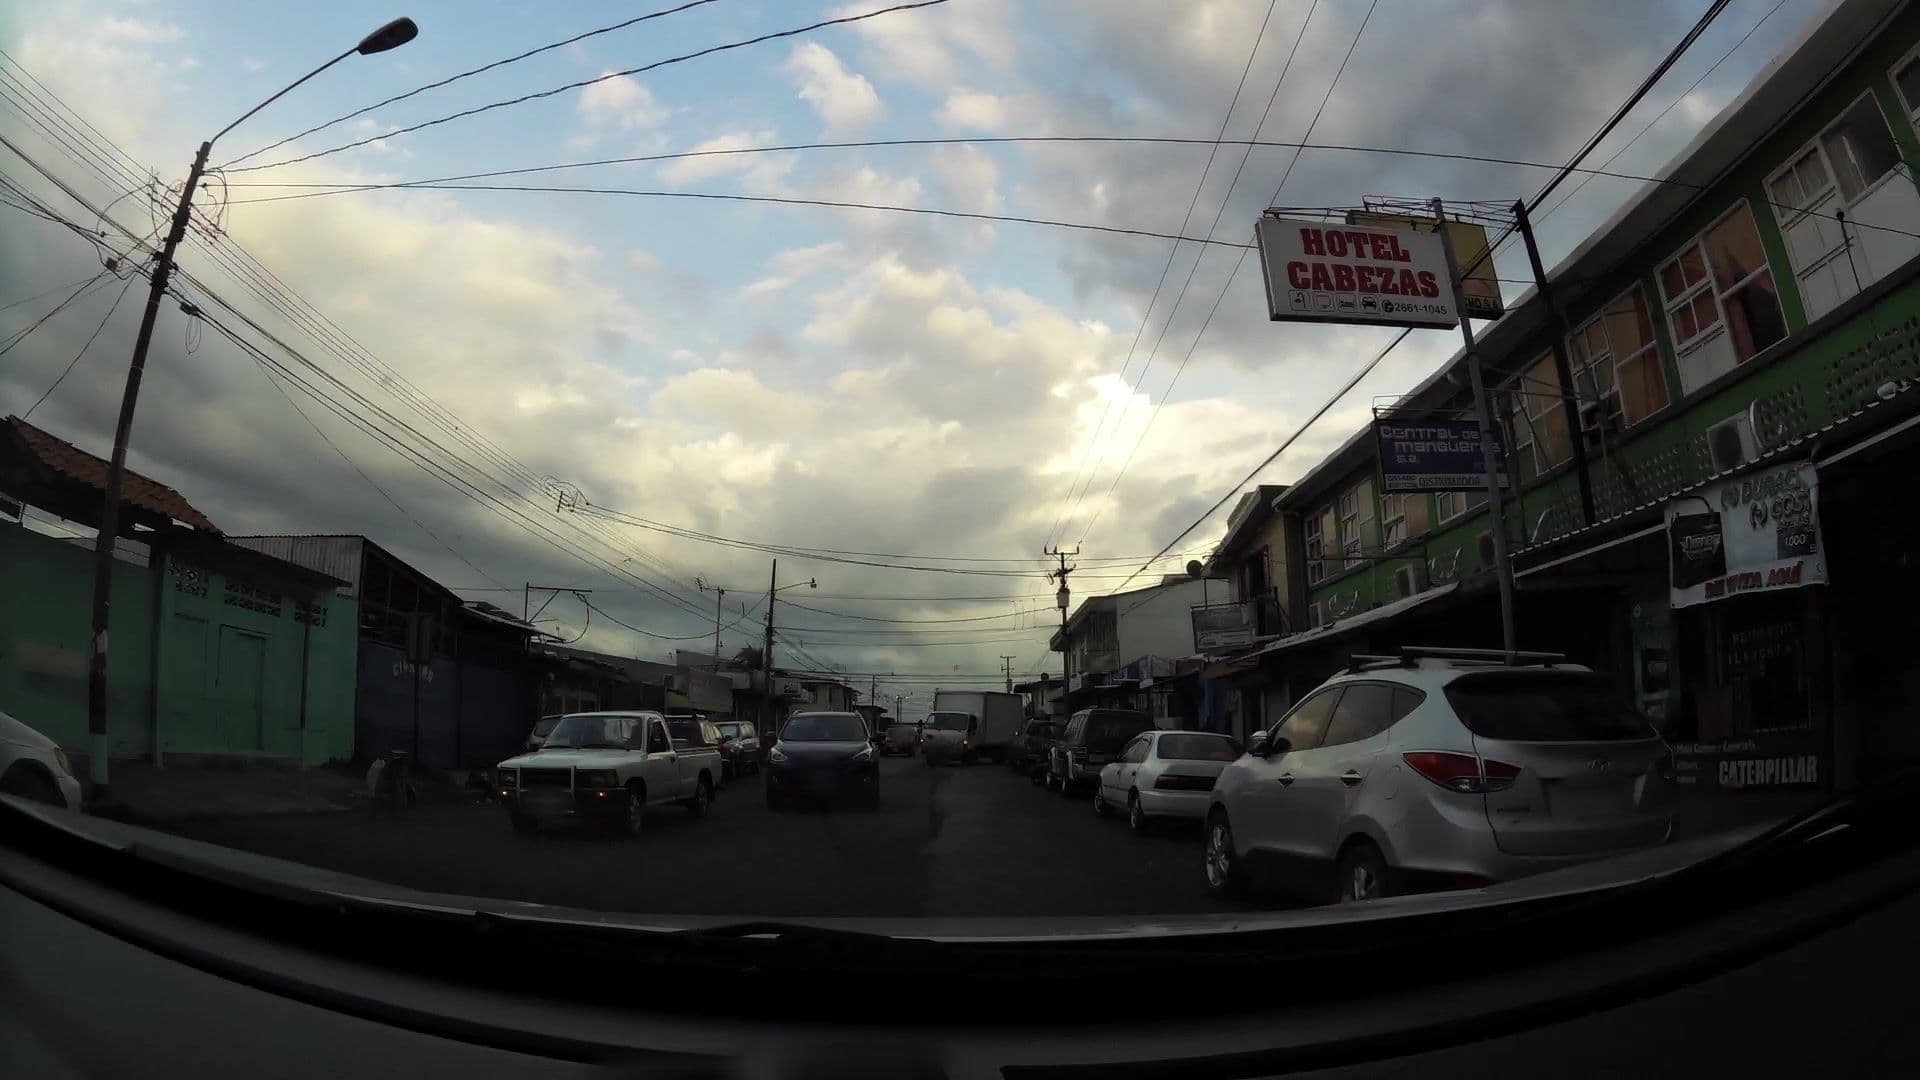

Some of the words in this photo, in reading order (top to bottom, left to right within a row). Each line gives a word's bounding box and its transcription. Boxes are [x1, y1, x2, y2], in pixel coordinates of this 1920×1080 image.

[1300, 228, 1411, 262] HOTEL
[1287, 261, 1439, 298] CABEZAS
[1395, 302, 1447, 315] 2661-1045
[1718, 755, 1818, 785] CATERPILLAR
